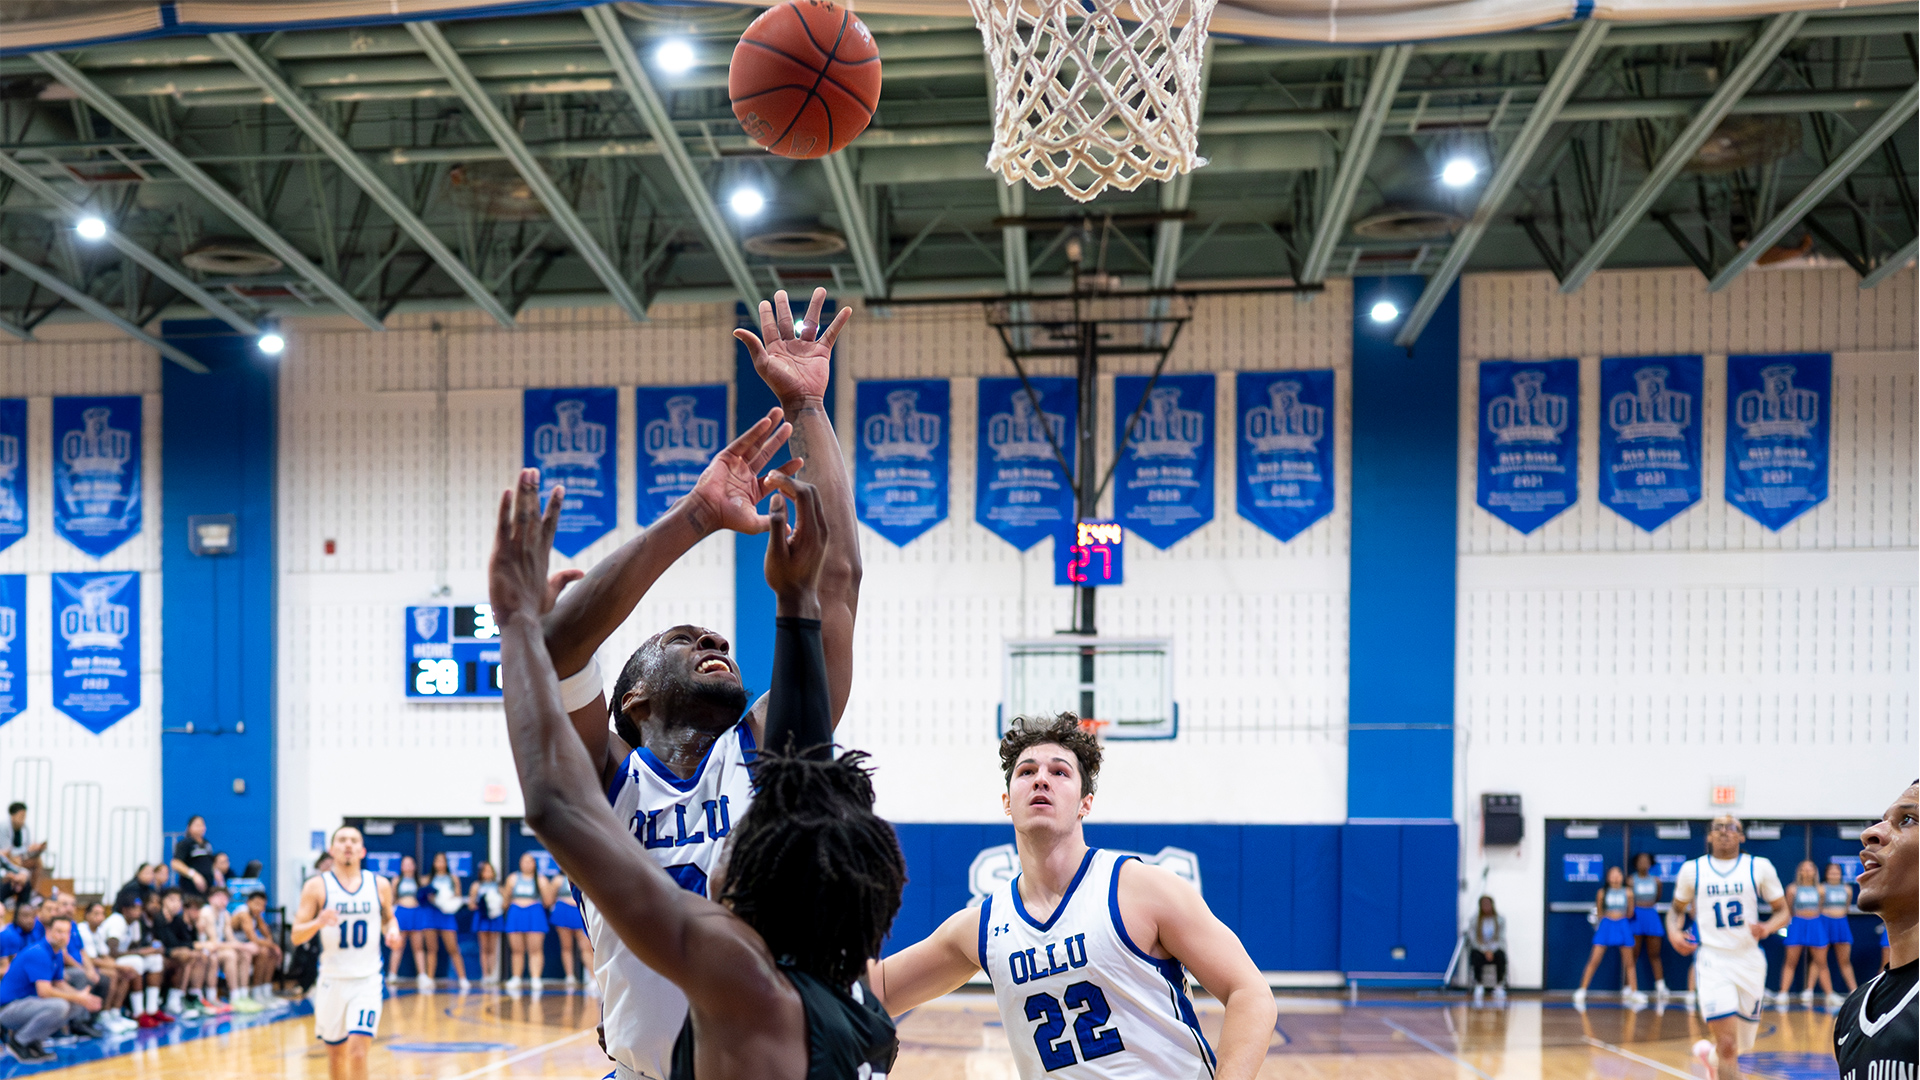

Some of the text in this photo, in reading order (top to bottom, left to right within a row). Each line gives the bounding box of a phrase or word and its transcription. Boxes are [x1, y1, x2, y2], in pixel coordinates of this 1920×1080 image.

[1247, 407, 1322, 441] OLLU
[1490, 397, 1566, 431] OLLU
[1611, 393, 1689, 428] OLLU
[1738, 392, 1817, 425] OLLU
[536, 425, 605, 457] OLLU
[646, 422, 717, 454] OLLU
[866, 416, 939, 448] OLLU
[1127, 413, 1201, 446] OLLU
[1067, 545, 1111, 582] 27
[63, 606, 127, 638] OLLU
[416, 659, 458, 694] 28
[629, 795, 731, 850] OLLU
[336, 902, 371, 914] OLLU
[1713, 901, 1744, 928] 12
[339, 919, 368, 949] 10
[1009, 933, 1088, 985] OLLU
[358, 1009, 376, 1028] 10
[1024, 980, 1126, 1073] 22
[1868, 1059, 1919, 1080] QUIN
